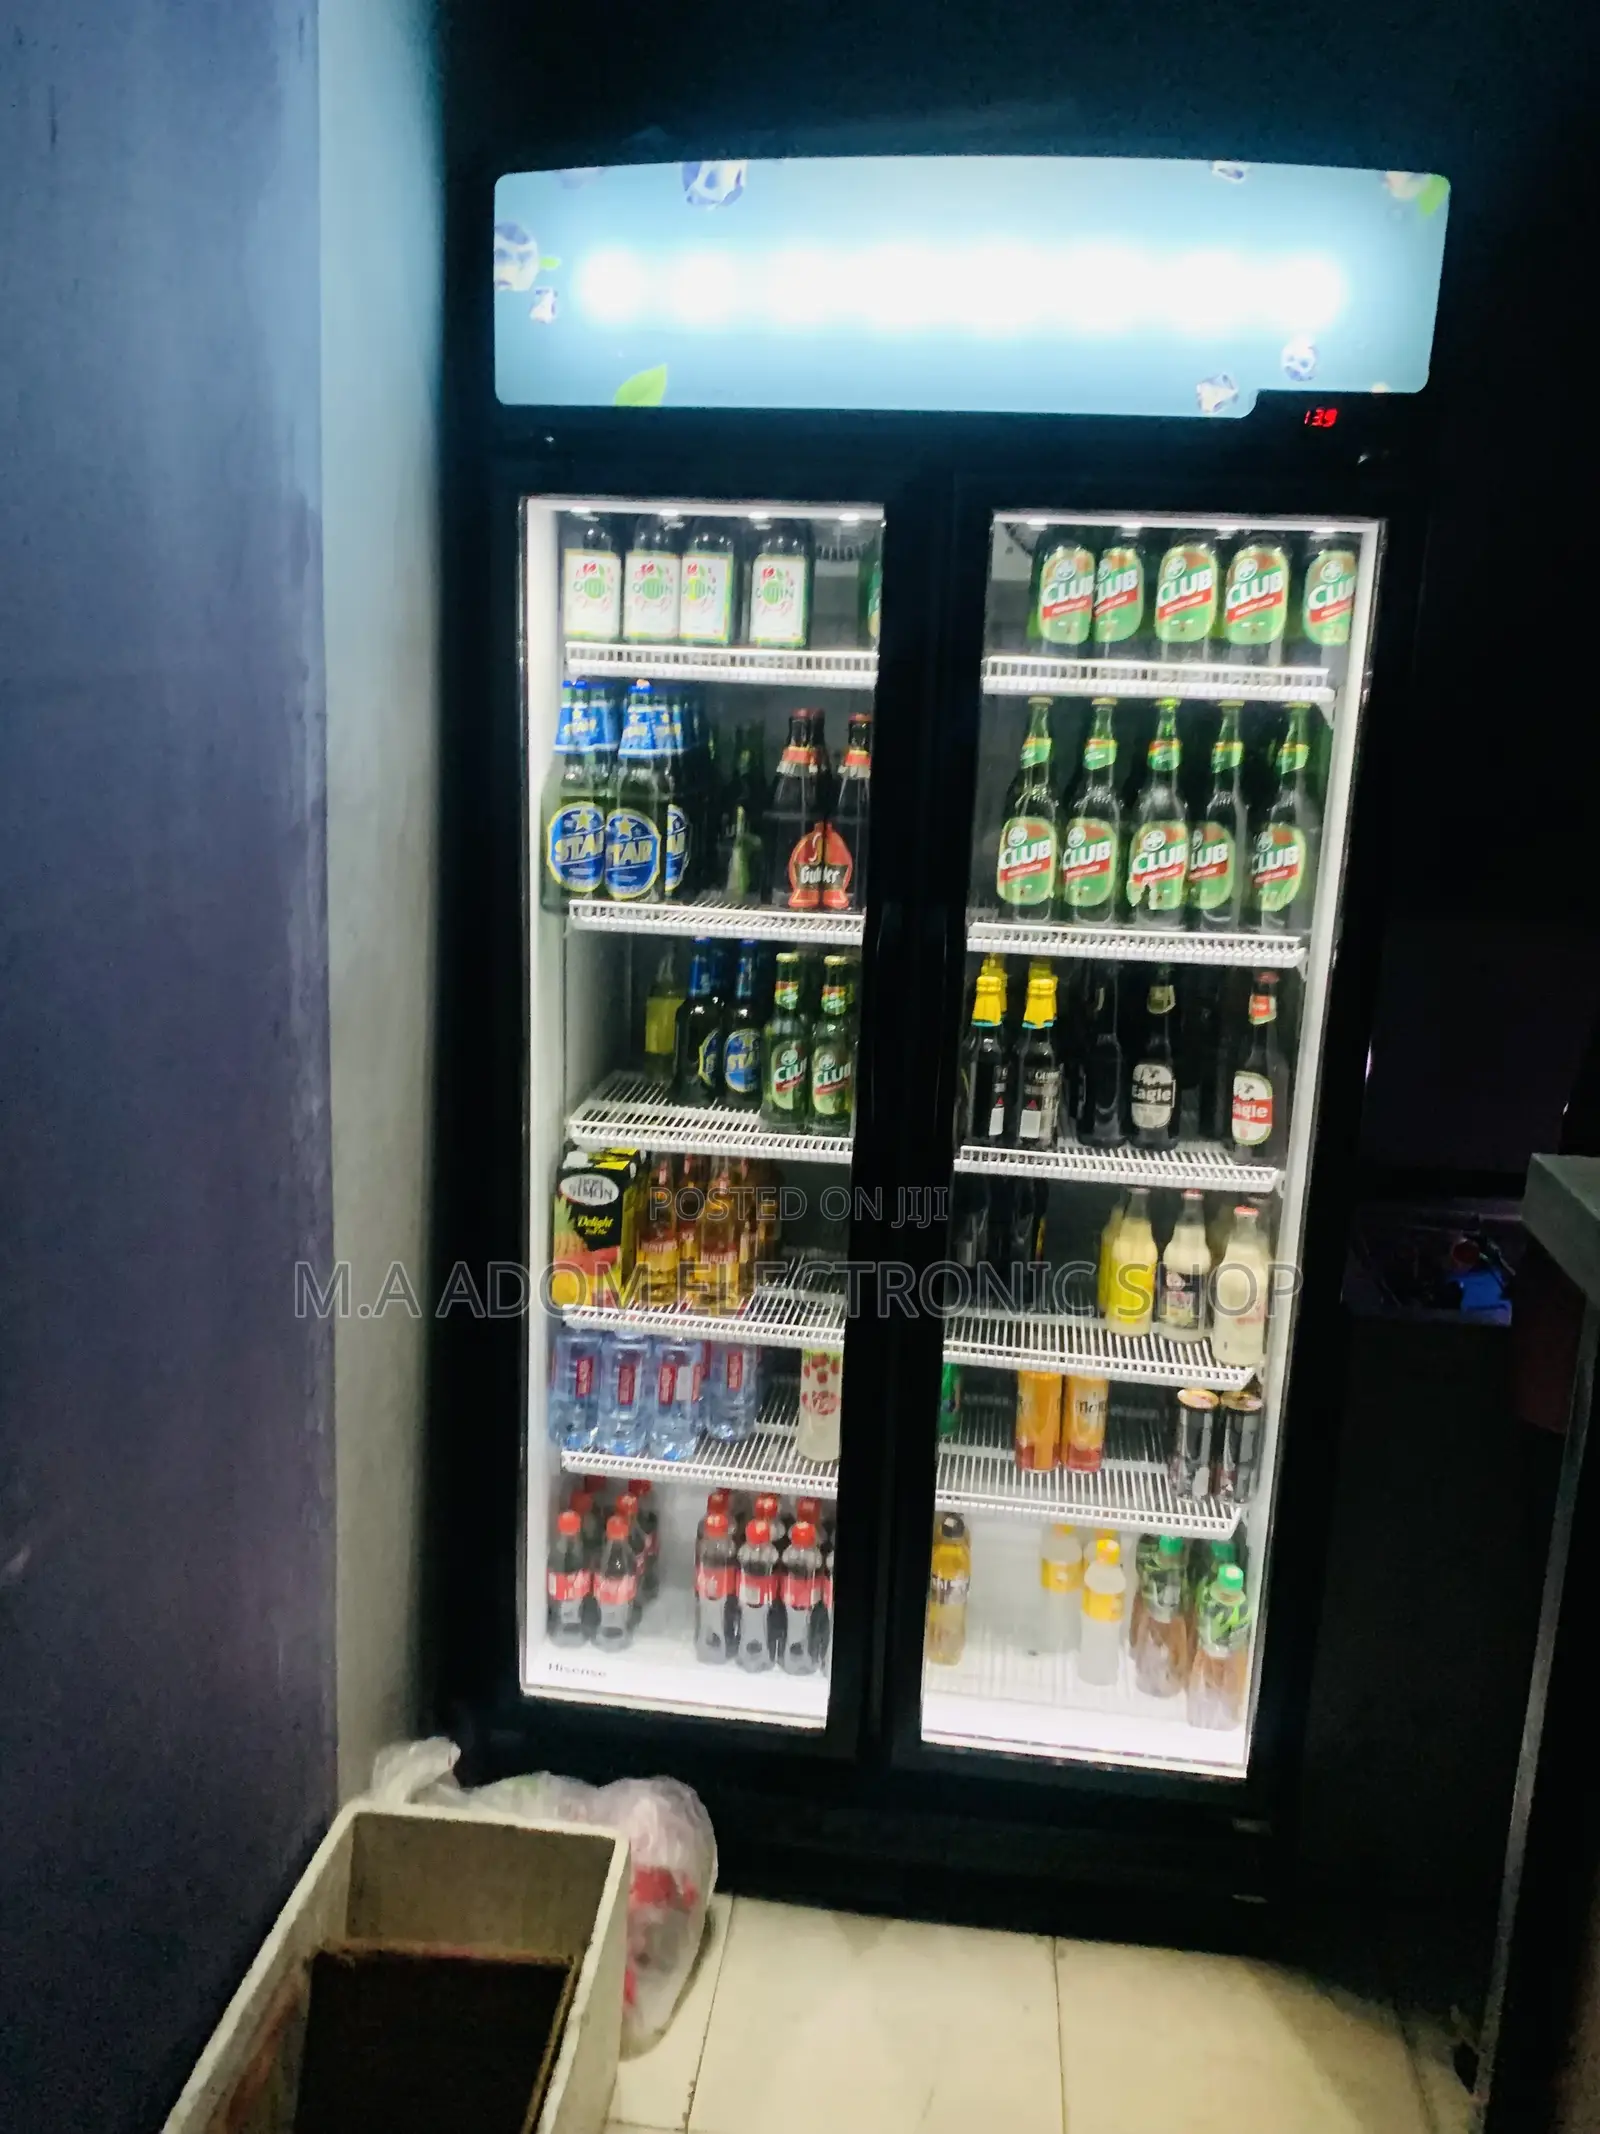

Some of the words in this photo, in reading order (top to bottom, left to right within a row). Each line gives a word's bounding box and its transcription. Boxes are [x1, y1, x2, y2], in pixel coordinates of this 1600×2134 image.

[1094, 569, 1139, 607] LUB
[1157, 568, 1213, 608] CLUB
[1226, 571, 1284, 610] CLUB
[605, 840, 653, 867] TAR
[998, 840, 1051, 870] CLUB
[1063, 841, 1112, 871] CLUB
[1189, 844, 1229, 872] LUB
[1233, 1102, 1270, 1120] agle
